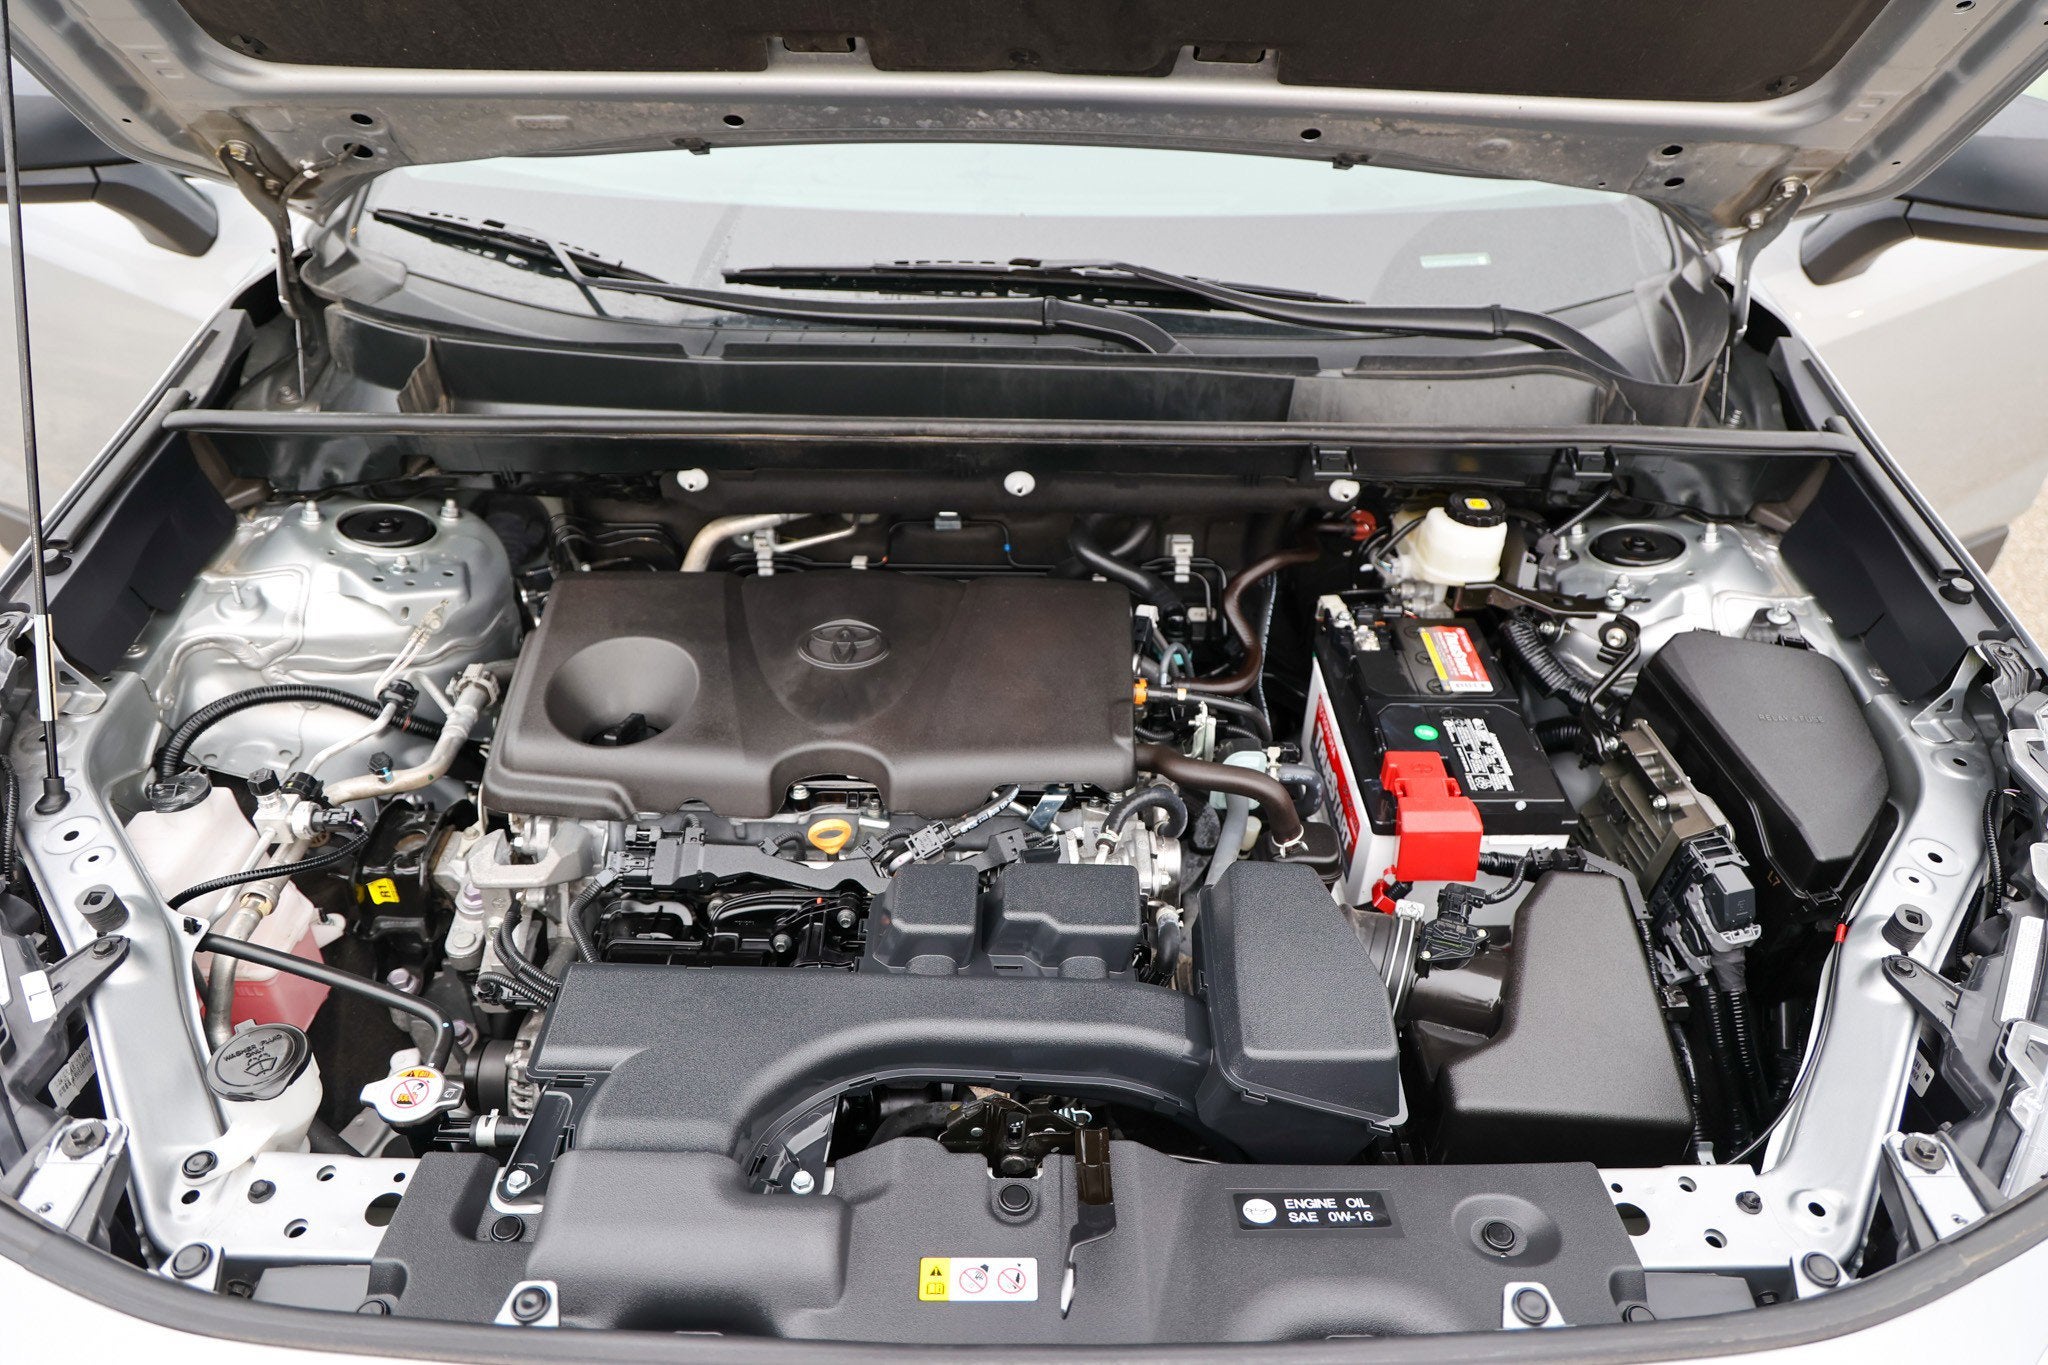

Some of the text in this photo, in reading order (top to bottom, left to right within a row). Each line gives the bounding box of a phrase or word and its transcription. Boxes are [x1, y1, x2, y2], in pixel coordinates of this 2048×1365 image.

[1758, 714, 1788, 722] RELAY
[1799, 714, 1825, 723] FUSE
[223, 1034, 283, 1061] WASHER FLUID
[246, 1046, 265, 1058] ONLY
[1283, 1197, 1371, 1210] ENGINE OIL
[1288, 1211, 1374, 1223] SAE 0W-16
